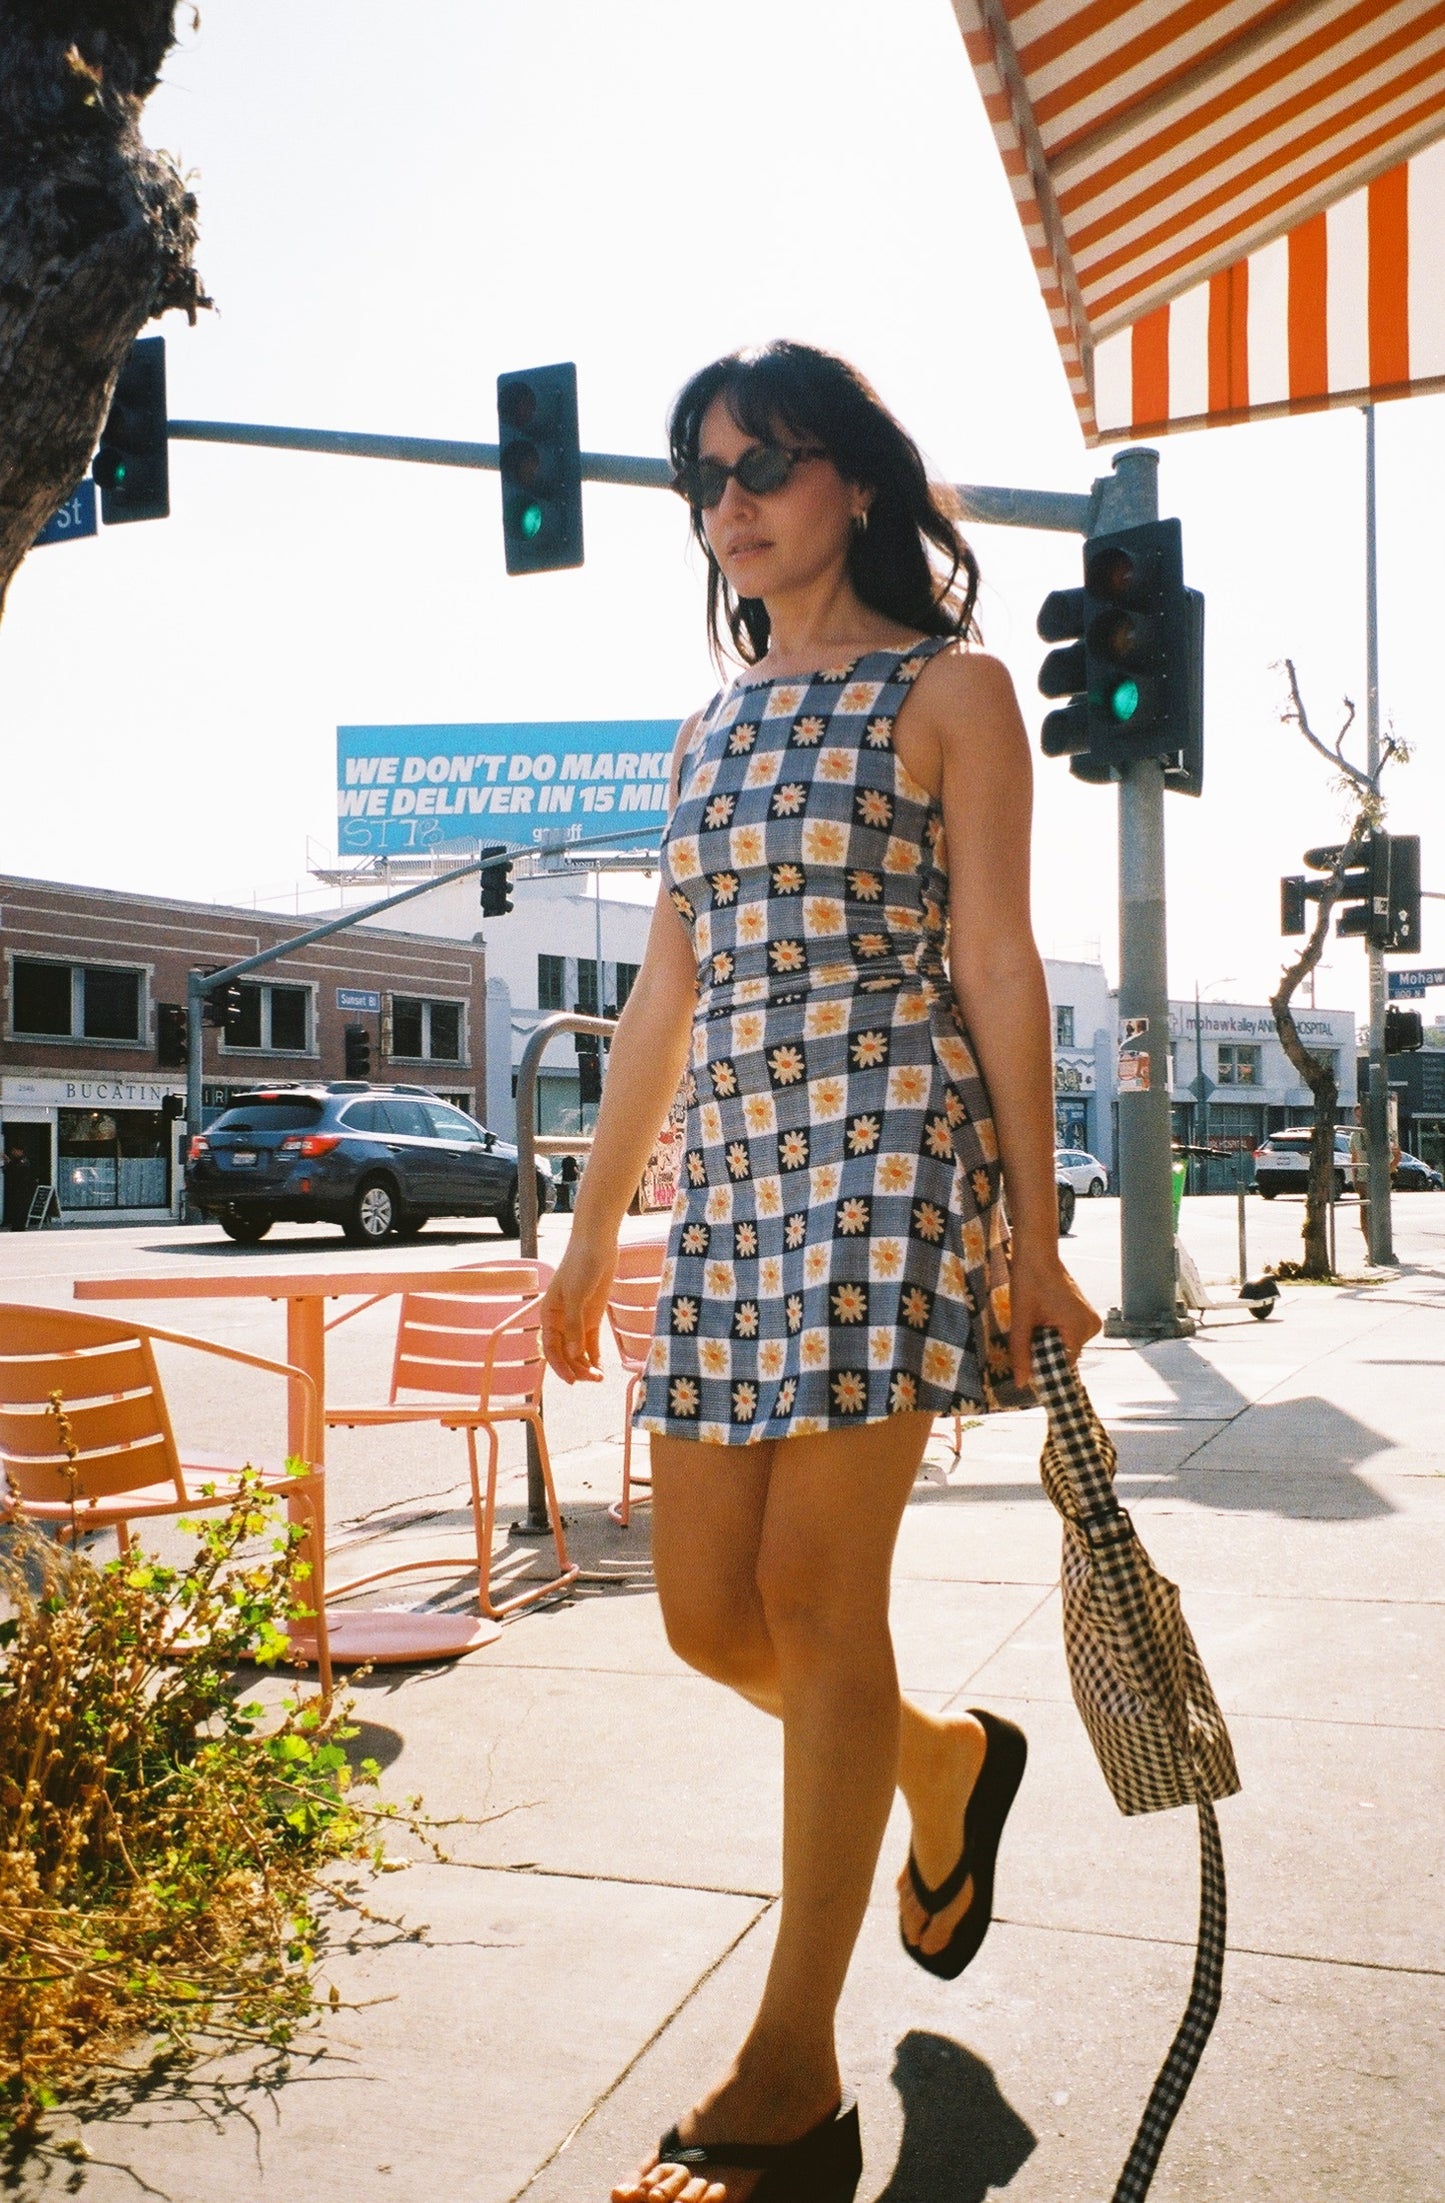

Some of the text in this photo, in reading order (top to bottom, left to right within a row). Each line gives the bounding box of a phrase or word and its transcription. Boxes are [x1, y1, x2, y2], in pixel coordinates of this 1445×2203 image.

[57, 498, 82, 528] St
[345, 757, 400, 784] WE
[401, 755, 507, 783] DON'T
[507, 754, 556, 781] DO
[338, 789, 389, 817] WE
[391, 786, 535, 815] DELIVER
[537, 786, 576, 813] IN
[580, 786, 616, 813] 15
[1400, 972, 1443, 985] Mohaw
[341, 993, 377, 1007] Sunset Bl
[66, 1083, 169, 1100] BUCATINI
[204, 1085, 226, 1104] IR
